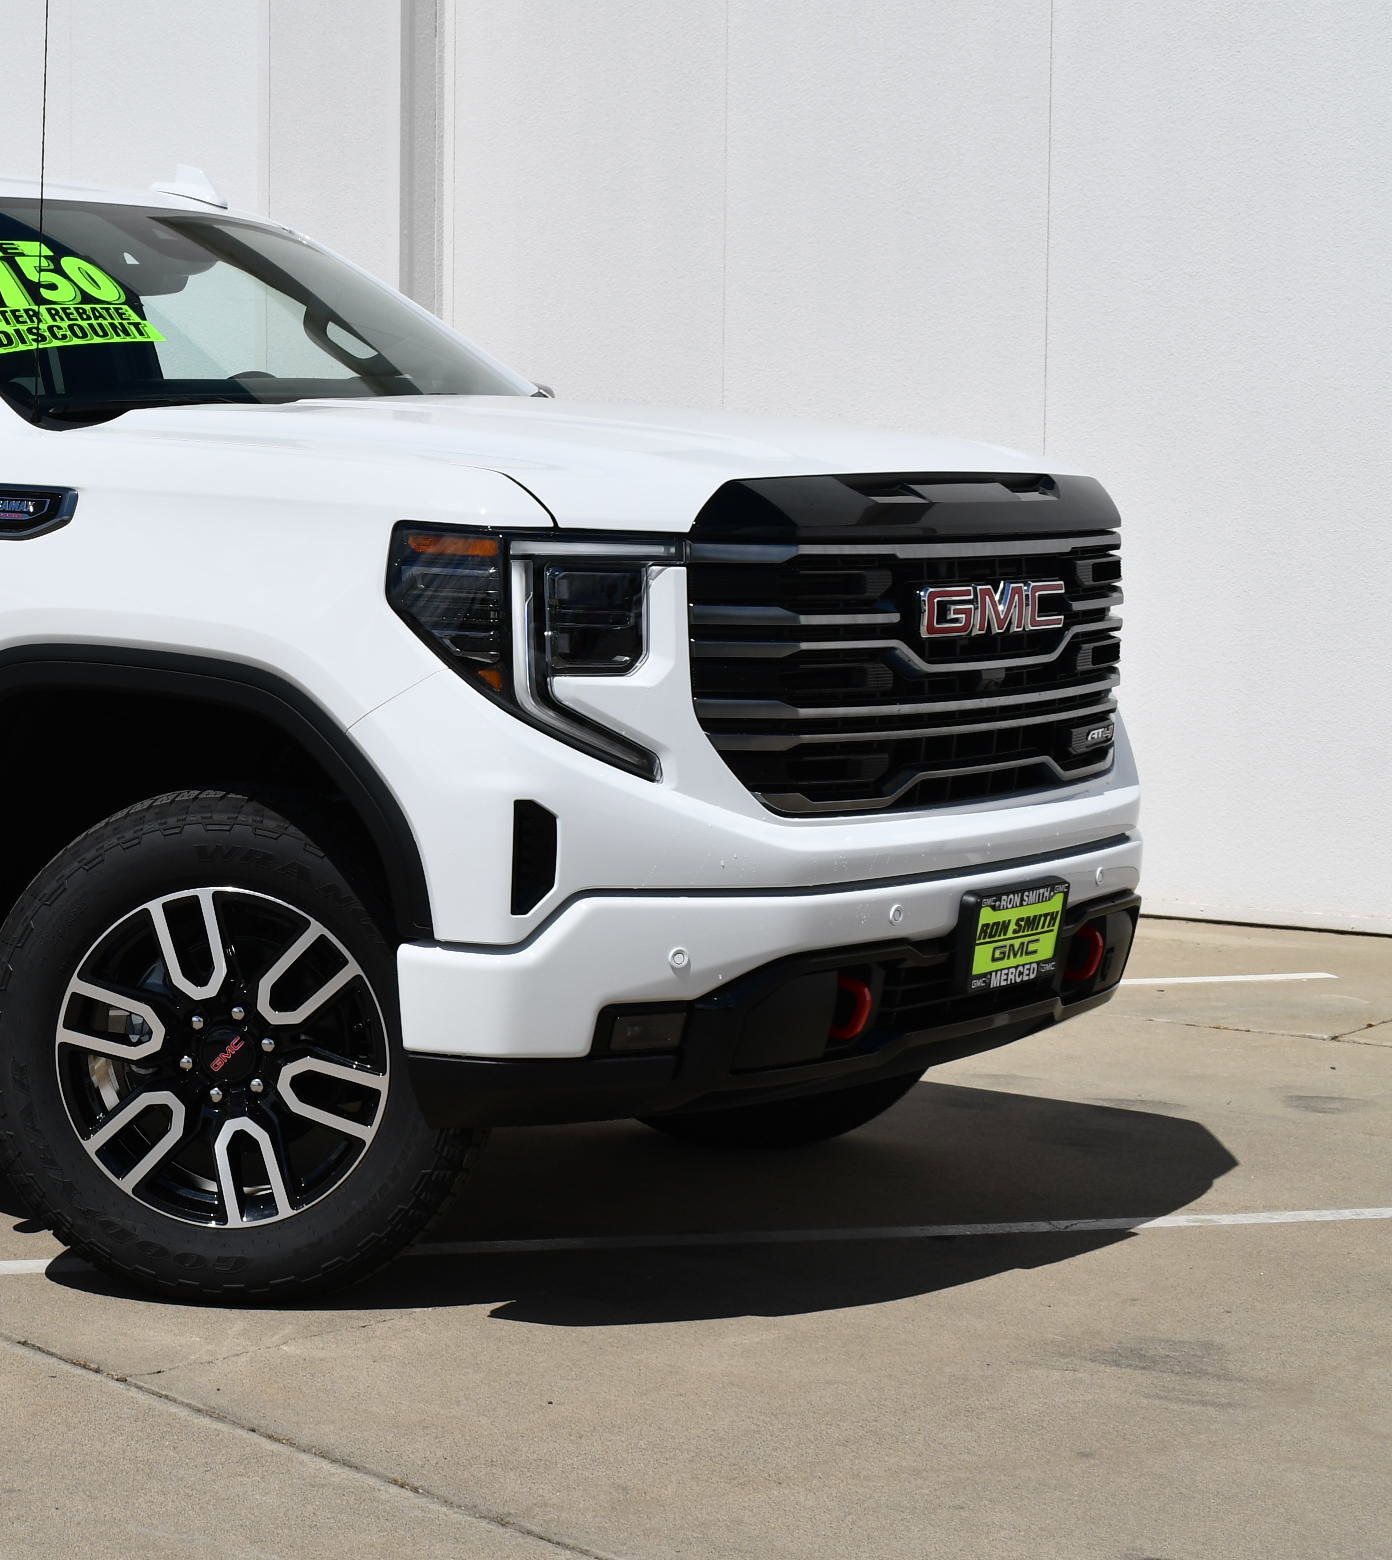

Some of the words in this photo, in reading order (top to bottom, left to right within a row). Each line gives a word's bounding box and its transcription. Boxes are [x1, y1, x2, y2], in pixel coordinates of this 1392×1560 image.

[50, 304, 131, 323] REBATE
[920, 581, 1065, 637] GMC
[1000, 894, 1020, 909] RON
[1023, 888, 1051, 905] SMITH
[976, 919, 1011, 940] RON
[1012, 911, 1059, 934] SMITH
[991, 939, 1040, 962] GMC
[991, 963, 1038, 988] MERCED
[210, 1036, 245, 1071] GMC
